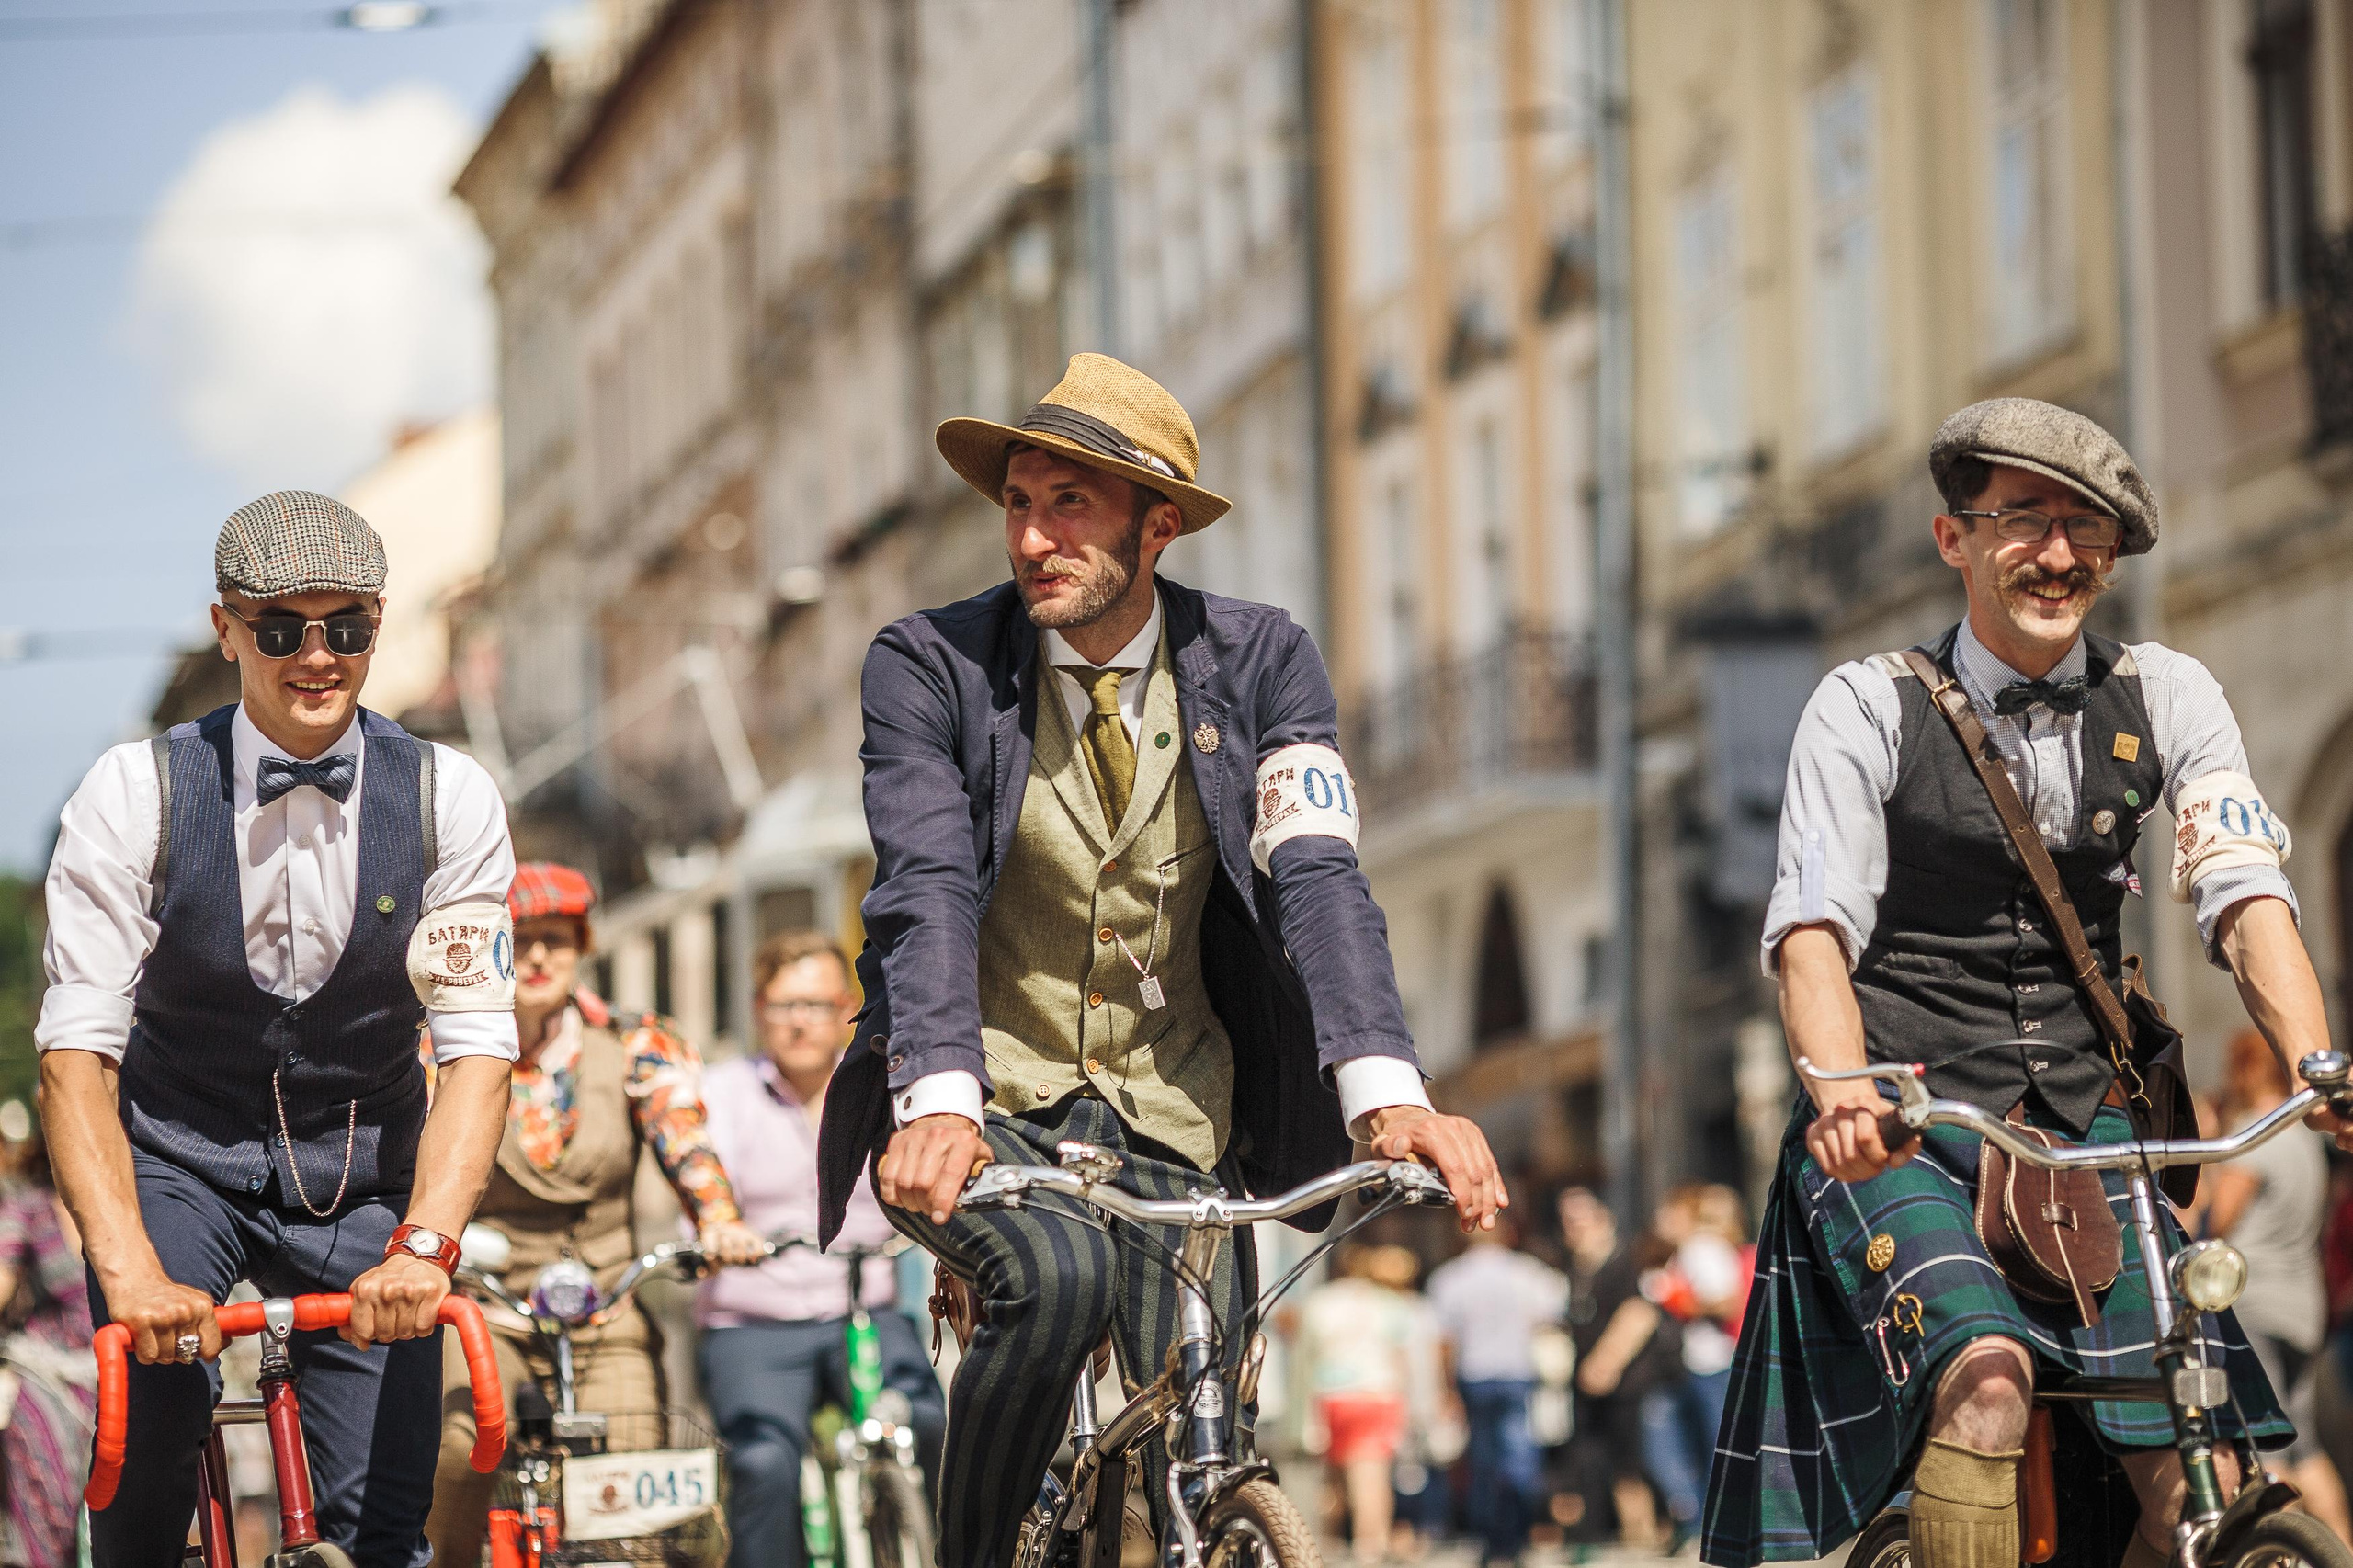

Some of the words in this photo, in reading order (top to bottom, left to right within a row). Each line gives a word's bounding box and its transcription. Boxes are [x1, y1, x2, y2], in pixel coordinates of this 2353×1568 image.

[1303, 767, 1355, 820] 01
[428, 926, 489, 945] БАТЯРИ
[493, 930, 515, 981] 0
[636, 1469, 702, 1509] 045
